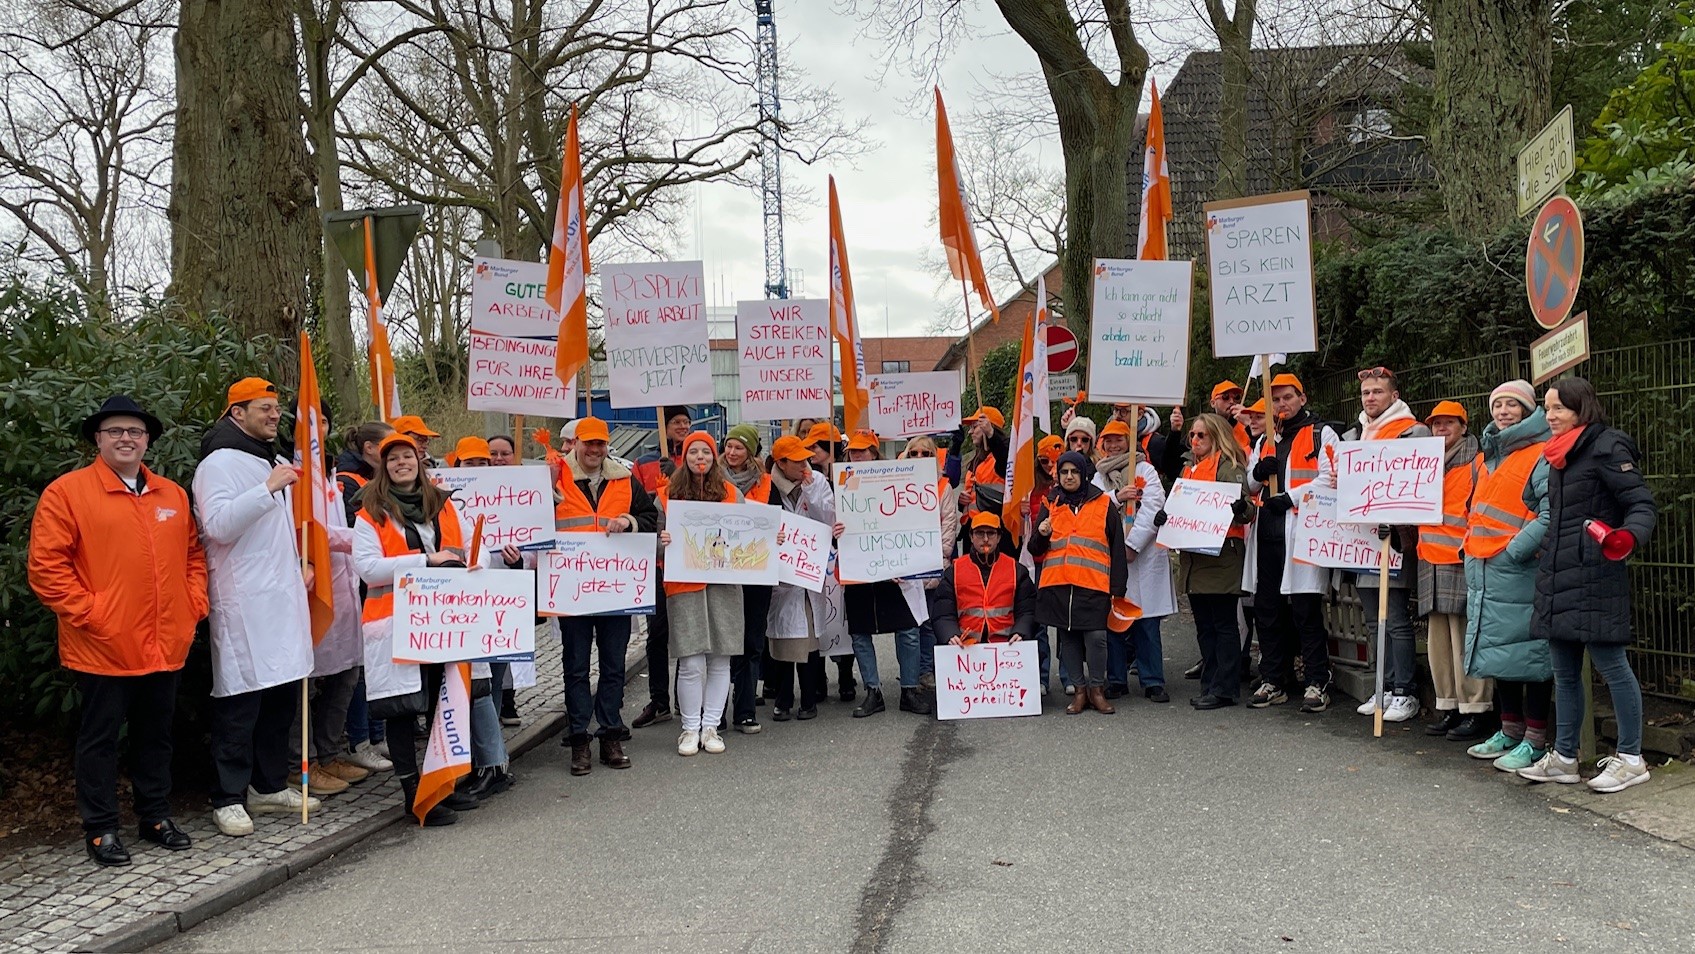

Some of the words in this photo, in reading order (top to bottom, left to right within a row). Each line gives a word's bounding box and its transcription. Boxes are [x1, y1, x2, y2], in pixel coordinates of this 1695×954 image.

[1524, 145, 1544, 175] Hier
[1548, 123, 1565, 157] gilt
[1525, 178, 1539, 201] die
[1544, 150, 1567, 184] StVO
[1218, 215, 1245, 224] Marburger
[1226, 225, 1301, 249] SPAREN
[490, 265, 518, 273] Marburger
[1218, 258, 1250, 276] BIS
[1260, 256, 1294, 272] KEIN
[505, 282, 546, 299] GUTE
[1121, 287, 1139, 302] kann
[1159, 287, 1178, 303] nicht
[1225, 281, 1295, 305] ARZT
[626, 308, 651, 325] GUTE
[656, 303, 703, 324] ARBEIT
[769, 305, 803, 321] WIR
[1117, 312, 1127, 321] so
[1132, 307, 1162, 321] schlecht
[749, 324, 827, 340] STREIKEN
[1102, 327, 1130, 342] arbeiten
[1135, 331, 1148, 342] wie
[1153, 329, 1165, 343] ich
[1225, 317, 1294, 334] KOMMT
[608, 343, 707, 369] TARIFVERTRAG
[744, 345, 785, 361] AUCH
[792, 344, 824, 360] FÜR
[1115, 350, 1142, 367] bezahlt
[476, 359, 512, 376] FÜR
[519, 366, 553, 381] IHRE
[760, 367, 815, 383] UNSERE
[470, 381, 570, 400] GESUNDHEIT
[902, 410, 934, 432] jetzt!
[855, 466, 894, 475] marburger
[895, 464, 915, 472] bund
[1342, 446, 1439, 484] Tarifvertrag
[450, 485, 542, 511] Schuften
[841, 493, 876, 513] Nur
[879, 483, 938, 516] JESUS
[1196, 491, 1234, 510] TARIF
[1315, 494, 1337, 502] Marburg
[1360, 472, 1426, 516] jetzt
[863, 518, 879, 530] hat
[859, 531, 939, 552] UMSONST
[546, 551, 648, 581] Tarifvertrag
[796, 549, 821, 575] Preis
[866, 553, 909, 576] geheilt
[408, 590, 428, 607] Im
[572, 577, 626, 601] jetzt
[410, 609, 431, 626] ist
[409, 630, 471, 650] NICHT
[481, 628, 521, 654] geil
[957, 654, 987, 674] Nur
[979, 647, 1023, 684] Jesus
[947, 677, 966, 691] hat
[973, 679, 1020, 691] umsonst
[960, 689, 1027, 714] geheilt!
[443, 708, 470, 757] bund
